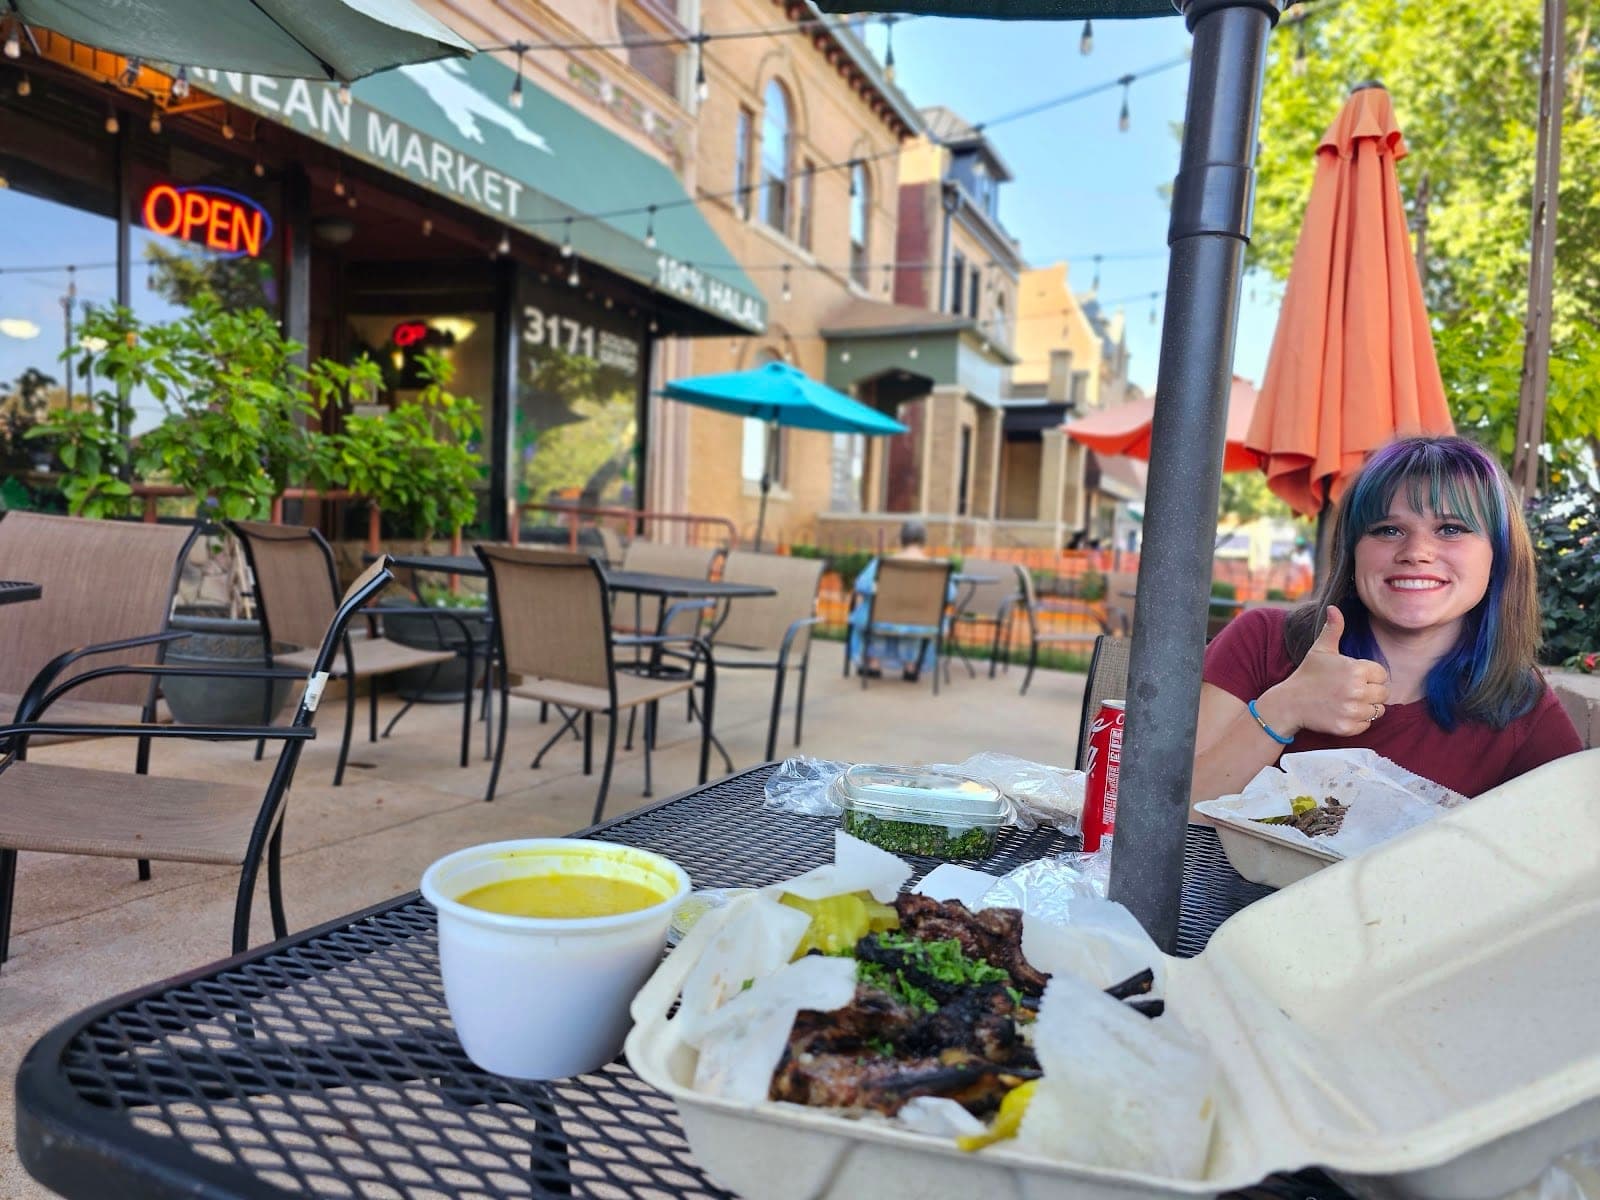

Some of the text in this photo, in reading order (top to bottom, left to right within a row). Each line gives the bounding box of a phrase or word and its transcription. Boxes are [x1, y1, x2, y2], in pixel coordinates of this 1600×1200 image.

[192, 67, 524, 217] NEAN MARKET
[144, 184, 263, 257] OPEN
[523, 305, 596, 359] 3171
